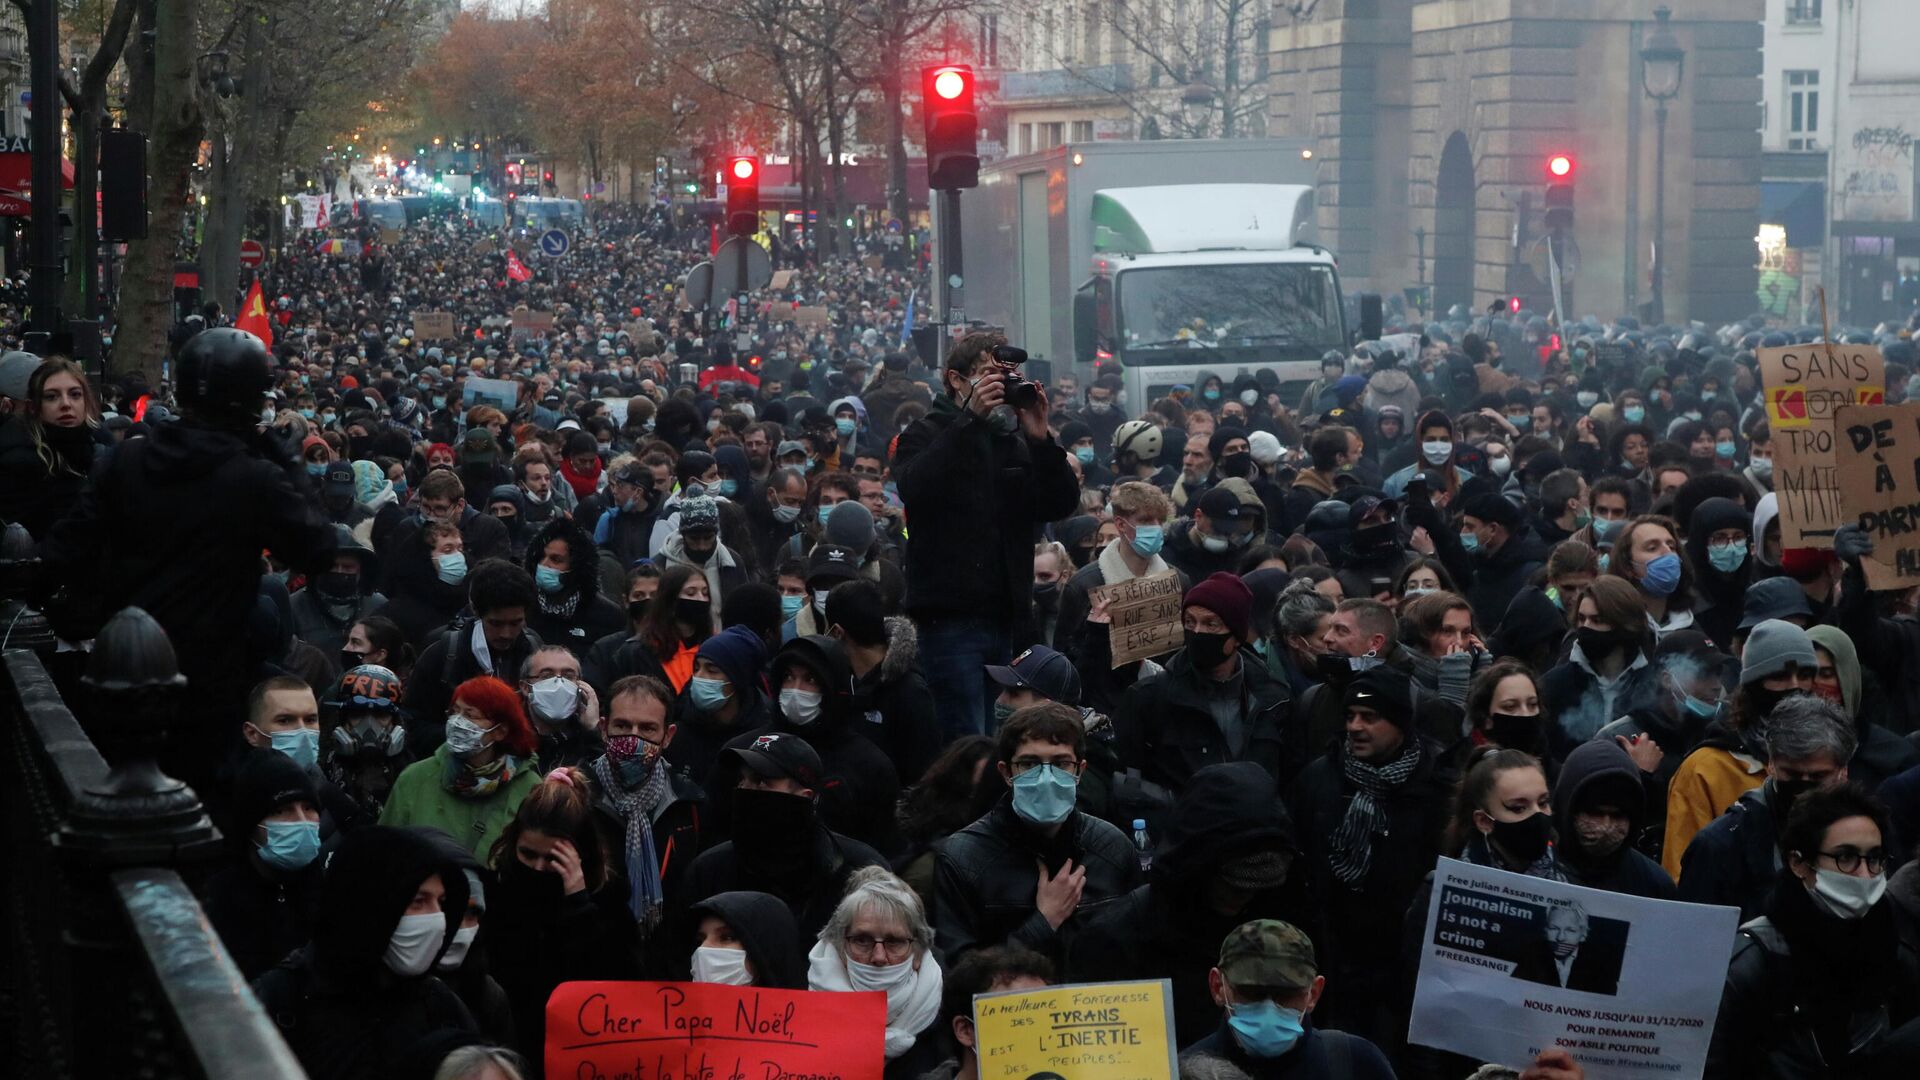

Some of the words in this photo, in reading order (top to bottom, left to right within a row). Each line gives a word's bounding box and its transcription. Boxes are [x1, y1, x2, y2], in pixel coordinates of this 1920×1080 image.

[1781, 352, 1871, 383] SANS
[1846, 418, 1896, 454] DE
[1872, 450, 1897, 494] À
[1124, 606, 1146, 629] RUE
[1152, 599, 1181, 619] SANS
[1126, 627, 1161, 651] ÊTRE
[1167, 622, 1175, 645] ?
[1443, 890, 1533, 921] Journalism
[1447, 874, 1469, 887] Free
[1469, 878, 1500, 893] Julian
[1502, 886, 1545, 903] Assange
[1547, 896, 1573, 908] now!
[1442, 909, 1456, 923] is
[1460, 915, 1487, 930] not
[1490, 922, 1502, 933] a
[1439, 929, 1486, 950] crime
[1435, 948, 1510, 973] #FREEASSANGE
[1072, 992, 1151, 1005] FORTERESSE
[577, 993, 642, 1037] Cher
[657, 986, 714, 1047] Papa
[735, 991, 795, 1041] Noël,
[1010, 1017, 1034, 1028] DES
[1049, 1008, 1121, 1024] TYRANS
[1523, 998, 1554, 1013] NOUS
[1555, 1005, 1592, 1019] AVONS
[1592, 1010, 1645, 1025] JUSQU'AU
[1646, 1015, 1704, 1029] 31/12/2020
[989, 1044, 1015, 1056] EST
[1039, 1027, 1142, 1052] L'INERTIE
[1555, 1036, 1579, 1048] SON
[1579, 1039, 1607, 1052] ASILE
[1608, 1043, 1661, 1056] POLITIQUE
[1566, 1023, 1597, 1036] POUR
[1598, 1027, 1657, 1041] DEMANDER
[577, 1061, 606, 1080] On
[615, 1057, 646, 1080] veut
[657, 1054, 672, 1080] la
[684, 1052, 714, 1080] bite
[728, 1056, 745, 1080] de
[759, 1061, 843, 1080] Darmanin
[1003, 1064, 1029, 1075] DES
